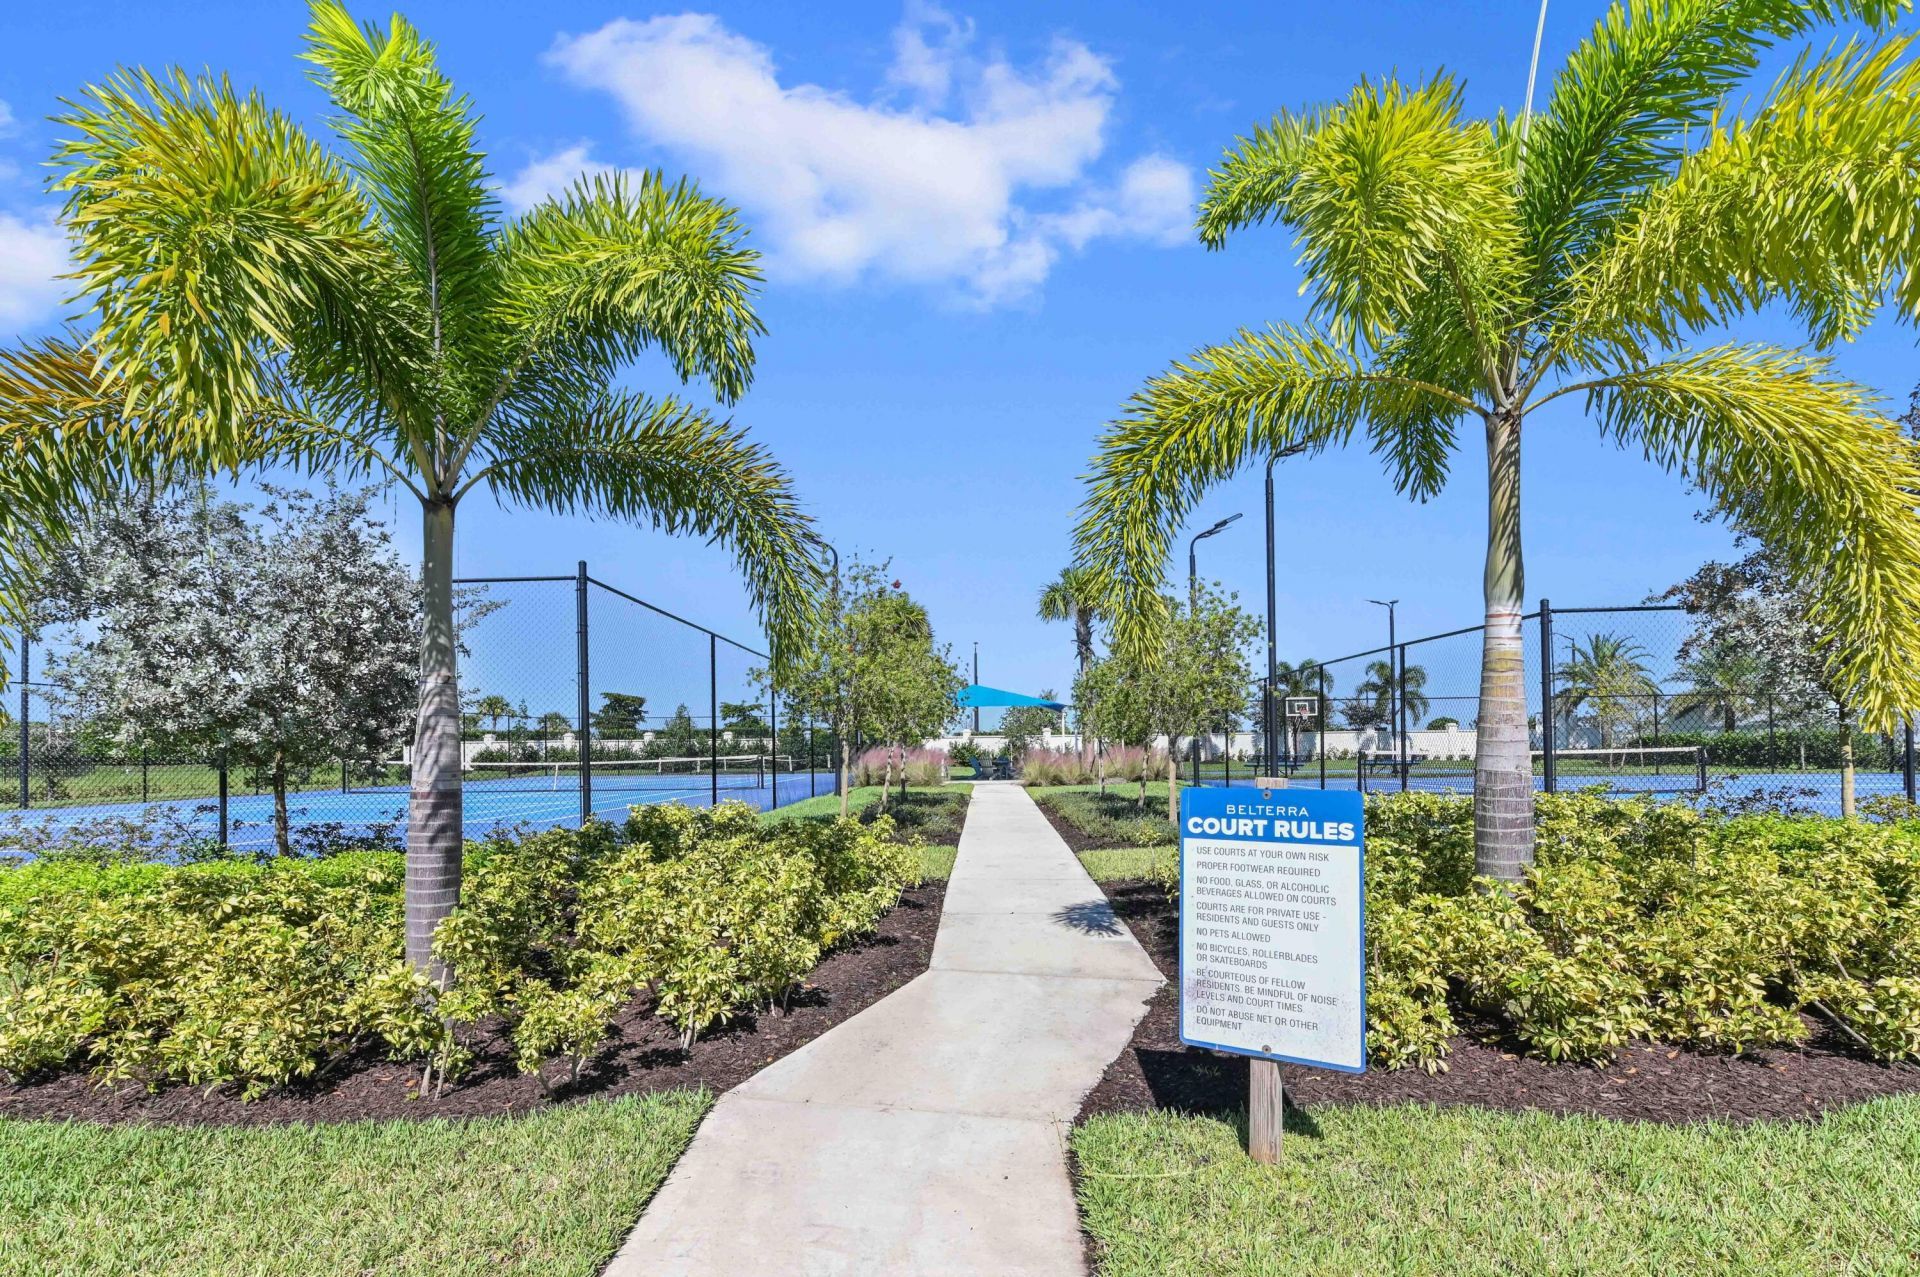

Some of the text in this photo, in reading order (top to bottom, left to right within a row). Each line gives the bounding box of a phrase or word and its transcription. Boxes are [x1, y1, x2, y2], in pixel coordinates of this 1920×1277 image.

[1227, 805, 1309, 817] BELTERRA
[1188, 817, 1355, 841] COURT RULES
[1196, 847, 1212, 855] USE
[1214, 848, 1246, 856] COURTS
[1260, 850, 1282, 858] YOUR
[1286, 851, 1306, 860] OWN
[1308, 852, 1329, 861] RISK
[1196, 862, 1320, 876] PROPER FOOTWEAR REQUIRED
[1196, 876, 1207, 884] NO
[1266, 881, 1278, 889] OR
[1281, 882, 1329, 893] ALCOHOLIC
[1196, 887, 1336, 906] BEVERAGES ALLOWED ON COURTS
[1196, 902, 1228, 912] COURTS
[1230, 904, 1245, 913] ARE
[1248, 906, 1264, 915] FOR
[1266, 908, 1300, 918] PRIVATE
[1303, 912, 1320, 920] USE
[1196, 913, 1319, 932] RESIDENTS AND GUESTS ONLY
[1196, 928, 1270, 942] NO PETS ALLOWED
[1196, 942, 1207, 950] NO
[1252, 949, 1318, 964] ROLLERBLADES
[1196, 953, 1268, 969] OR SKATEBOARDS
[1208, 970, 1256, 983] COURTEOUS
[1259, 976, 1269, 984] OF
[1272, 978, 1305, 989] FELLOW
[1196, 991, 1224, 1001] LEVELS
[1228, 995, 1244, 1004] AND
[1246, 998, 1273, 1008] COURT
[1245, 986, 1254, 994] BE
[1258, 988, 1295, 1000] MINDFUL
[1298, 993, 1308, 1001] OF
[1311, 995, 1337, 1005] NOISE
[1196, 1006, 1318, 1030] DO NOT ABUSE NET OR OTHER
[1196, 1016, 1242, 1030] EQUIPMENT
